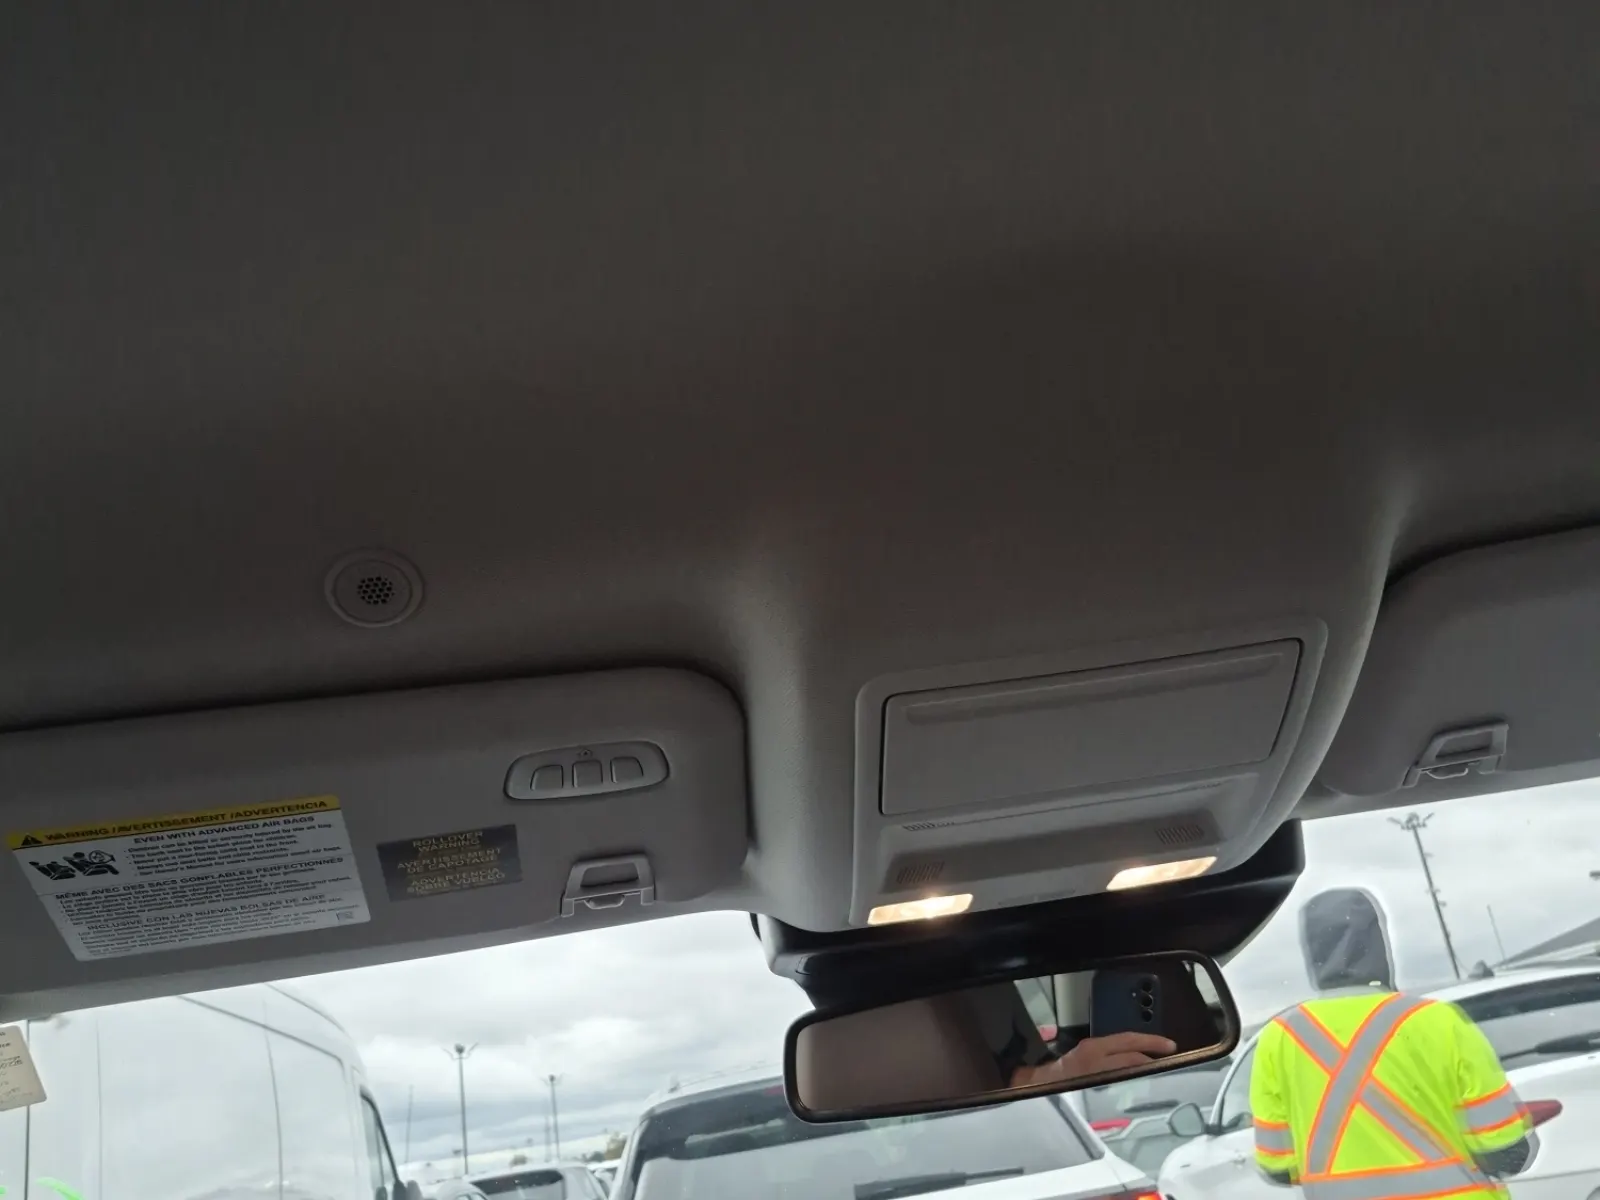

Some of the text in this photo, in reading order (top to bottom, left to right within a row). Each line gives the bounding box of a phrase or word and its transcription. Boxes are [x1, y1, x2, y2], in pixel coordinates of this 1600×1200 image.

[45, 828, 110, 841] WARNING
[134, 816, 315, 844] EVEN WITH ADVANCED AIR BAGS
[412, 831, 483, 847] ROLLOVER
[418, 839, 480, 852] WARNING
[397, 848, 502, 869] AVERTISSEMENT
[428, 855, 498, 870] CAPOTAGE
[55, 890, 89, 900] MÊME
[91, 886, 122, 895] AVEC
[123, 883, 146, 892] DES
[148, 879, 178, 888] SACS
[180, 869, 254, 884] GONFLABLES
[407, 873, 506, 893] SOBRE VUELCO
[411, 868, 500, 886] ADVERTENCIA
[87, 919, 143, 931] INCLUSIVE
[172, 912, 193, 920] LAS
[195, 906, 238, 916] NUEVAS
[240, 900, 282, 911] BOLSAS
[302, 894, 326, 902] AIRE
